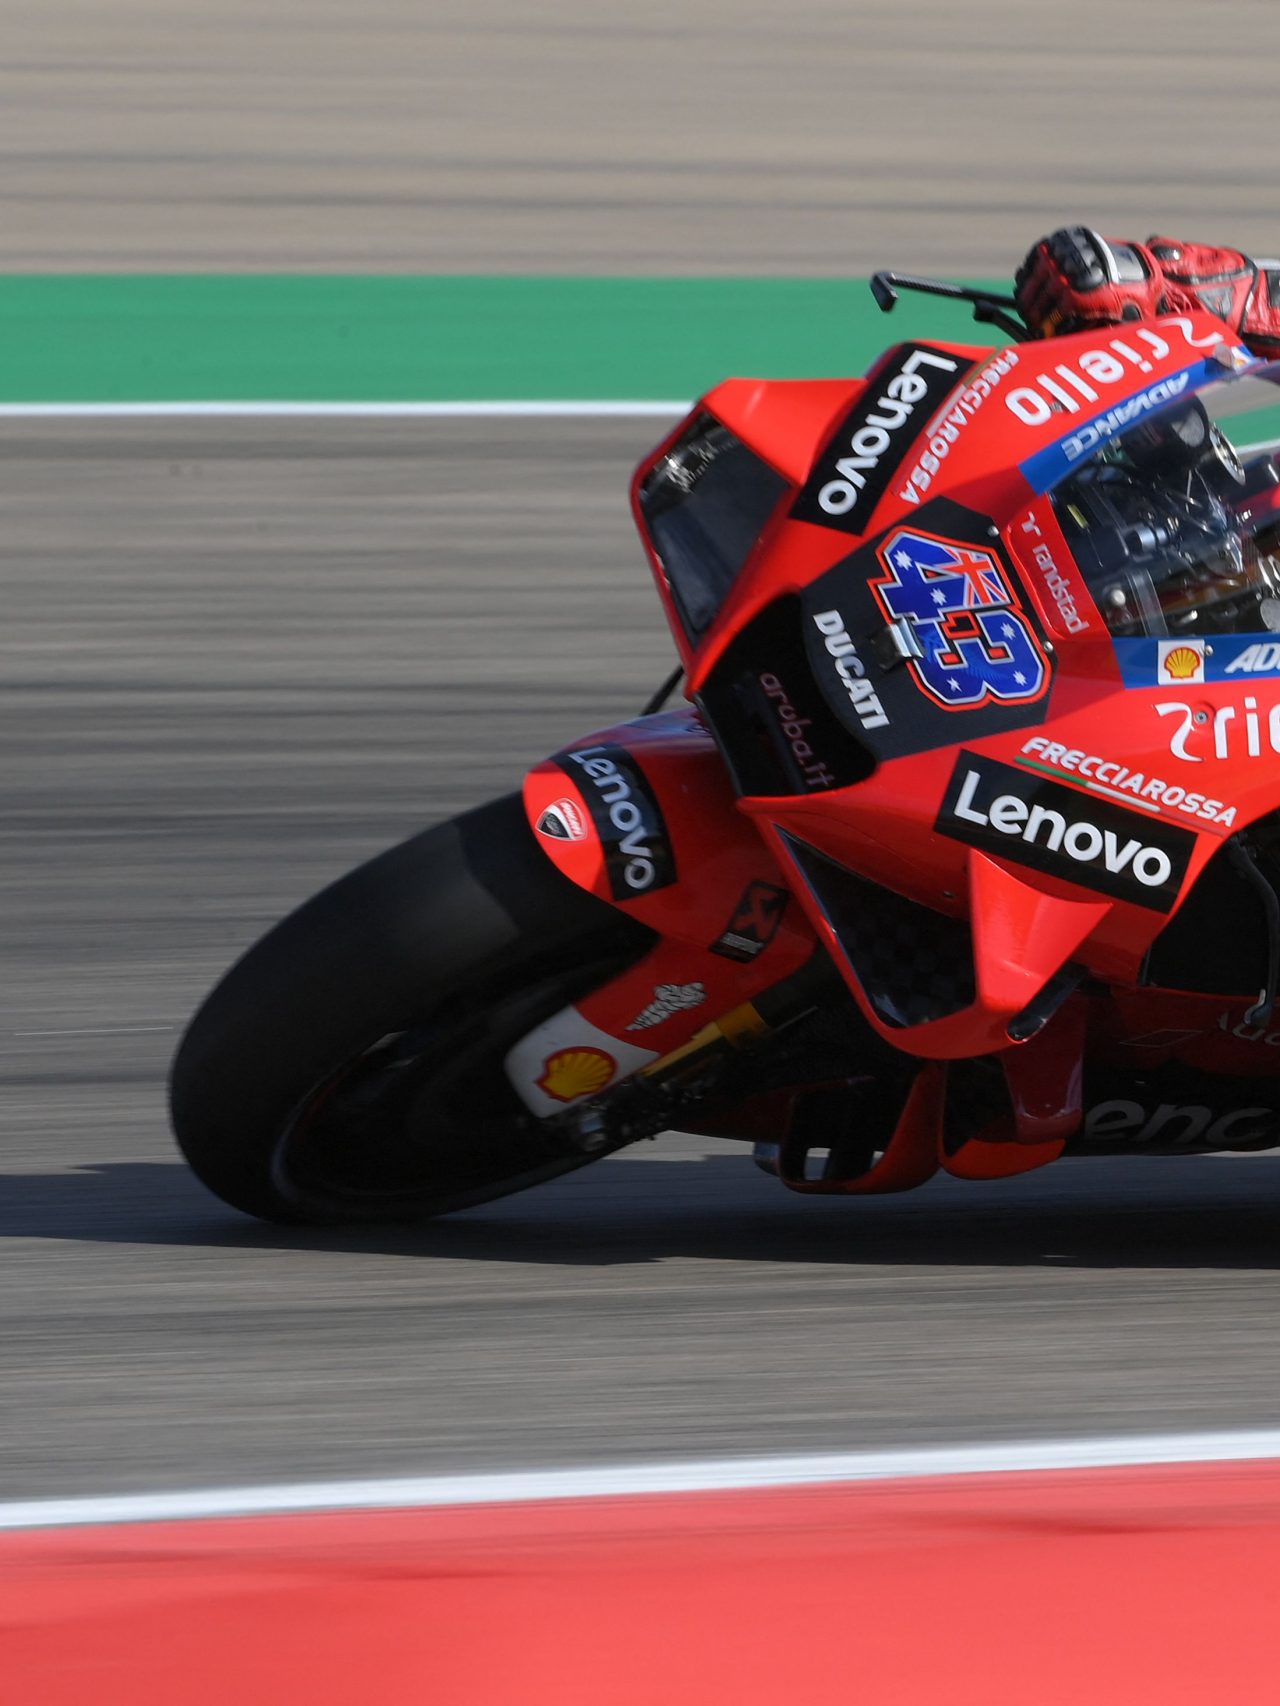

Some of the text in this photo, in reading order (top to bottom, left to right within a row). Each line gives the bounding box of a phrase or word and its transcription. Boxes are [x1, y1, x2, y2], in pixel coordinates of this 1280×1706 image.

[818, 349, 958, 516] Lenovo
[900, 349, 1020, 505] FRECCIAROSSA
[1005, 328, 1171, 426] riello
[1061, 371, 1189, 462] ADVANCE
[867, 525, 1052, 712] 43
[1031, 542, 1090, 635] randstad
[812, 609, 891, 730] DUCATI
[759, 672, 836, 788] aruba.it
[1021, 736, 1239, 828] FRECCIAROSSA
[569, 747, 656, 890] Lenovo
[954, 769, 1173, 888] Lenovo
